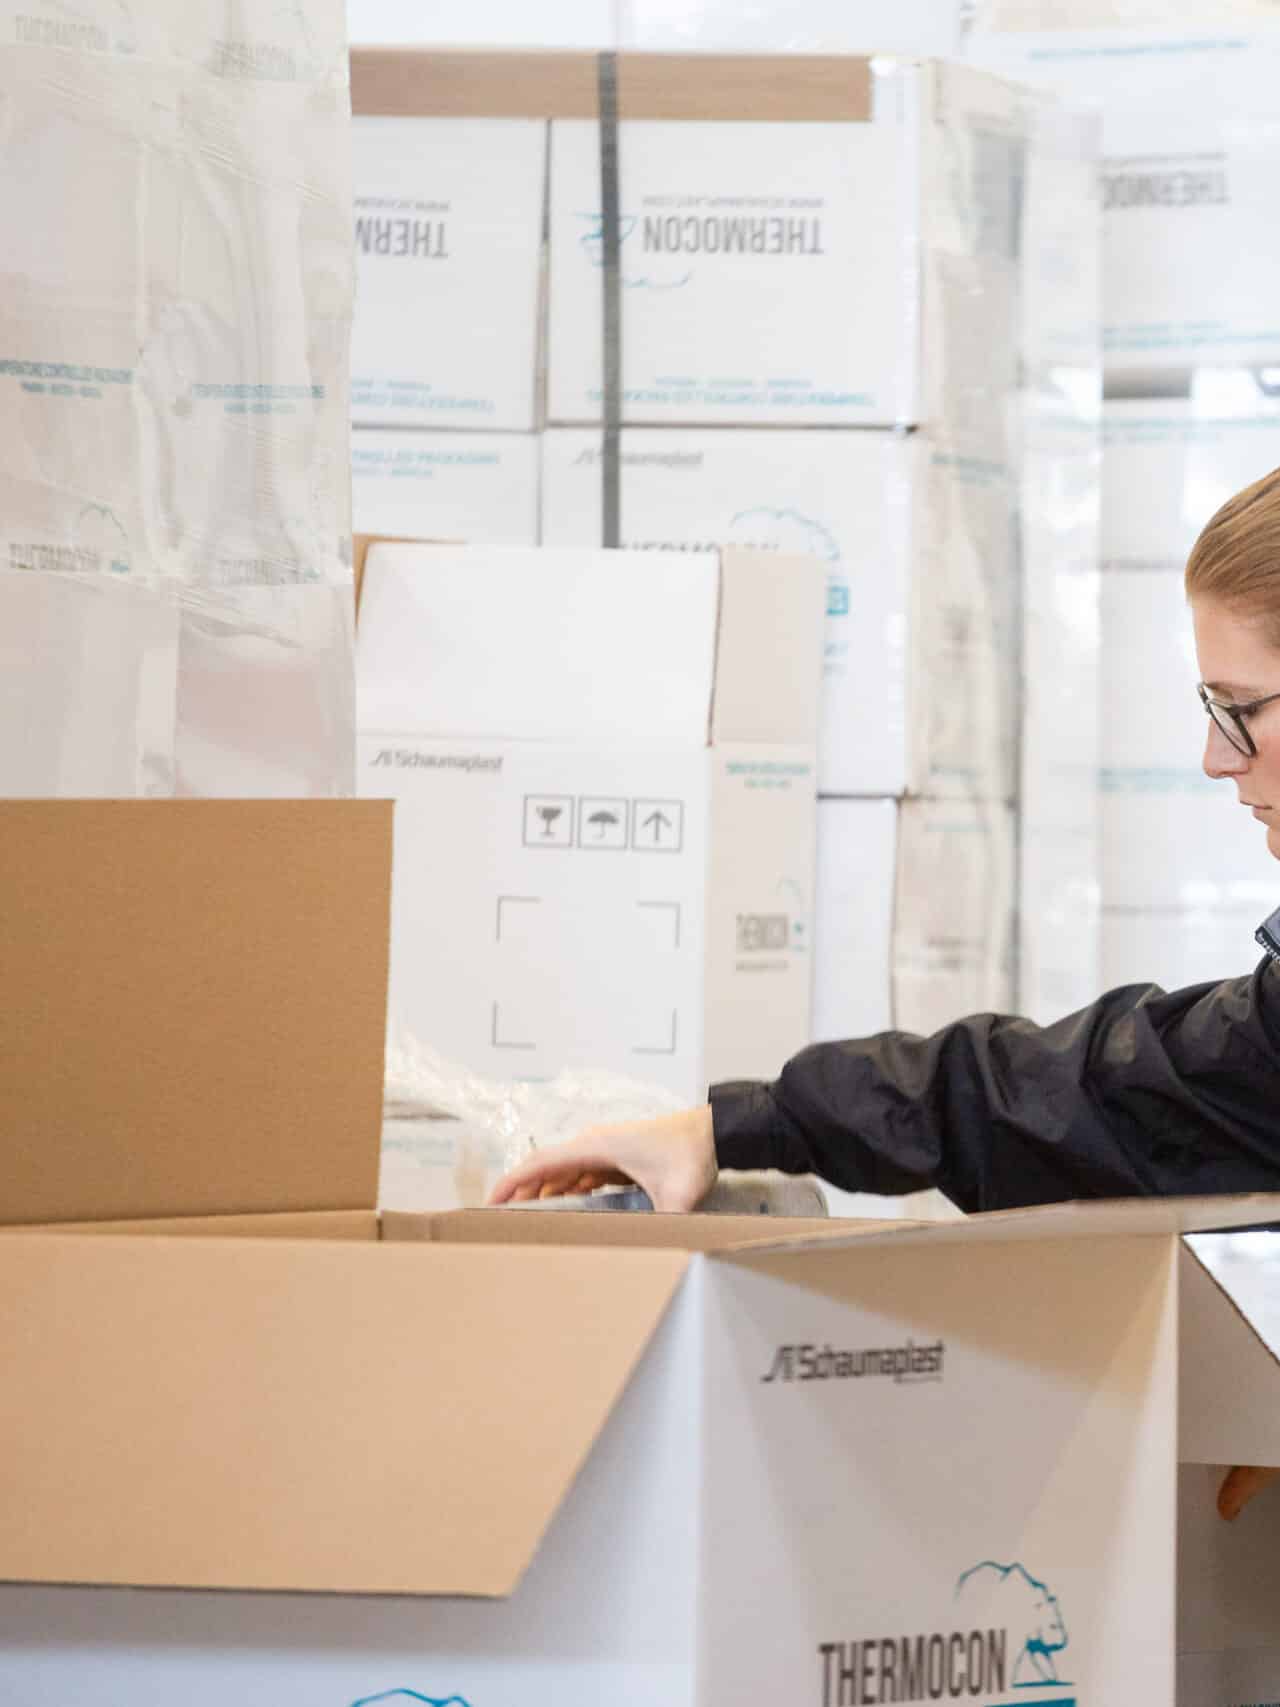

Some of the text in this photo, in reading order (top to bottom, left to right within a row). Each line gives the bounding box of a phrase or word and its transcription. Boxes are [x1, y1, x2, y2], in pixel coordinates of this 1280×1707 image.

[355, 219, 449, 258] THERM
[642, 216, 824, 255] THERMOCON
[799, 1338, 945, 1382] Schaumaplast
[818, 1628, 1006, 1707] THERMOCON
